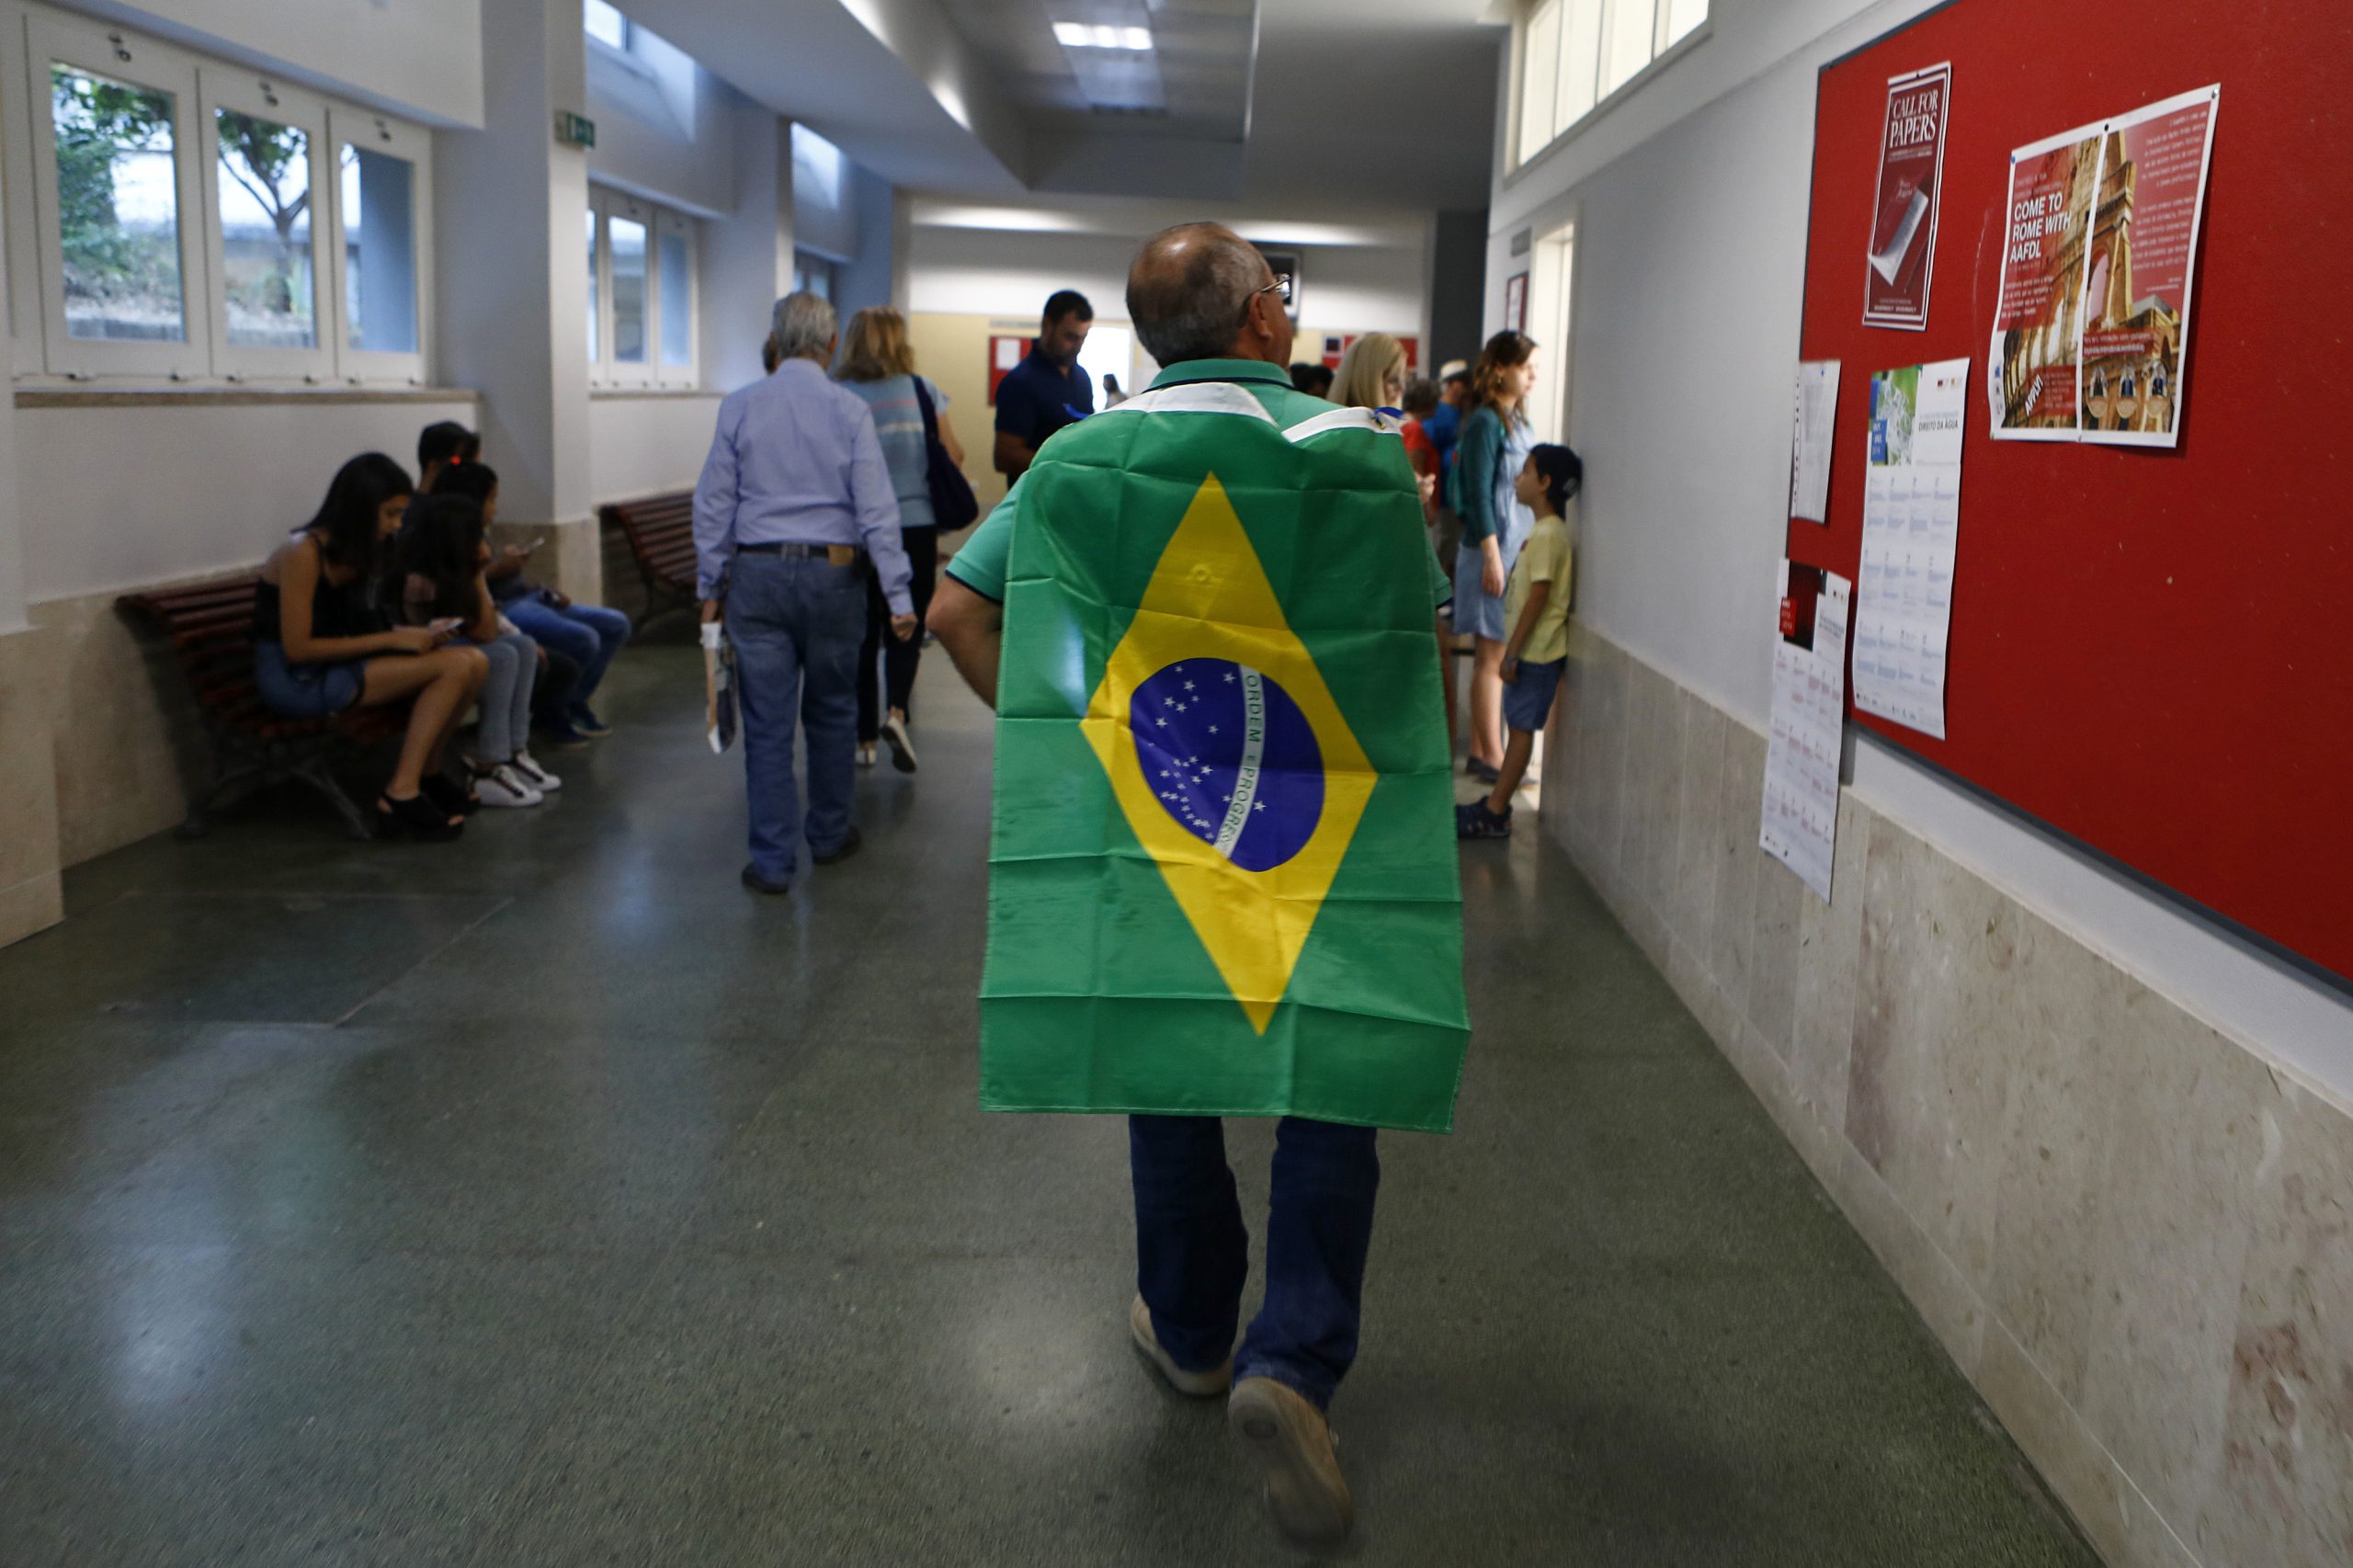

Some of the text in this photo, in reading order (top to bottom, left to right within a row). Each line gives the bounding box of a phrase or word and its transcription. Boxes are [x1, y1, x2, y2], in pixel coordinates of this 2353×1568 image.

[1893, 89, 1938, 119] CALL FOR
[1890, 111, 1937, 149] PAPERS
[2014, 191, 2063, 222] COME TO
[2012, 210, 2072, 242] ROME WITH
[2009, 240, 2041, 264] AAFDL
[1245, 675, 1263, 743] ORDEM
